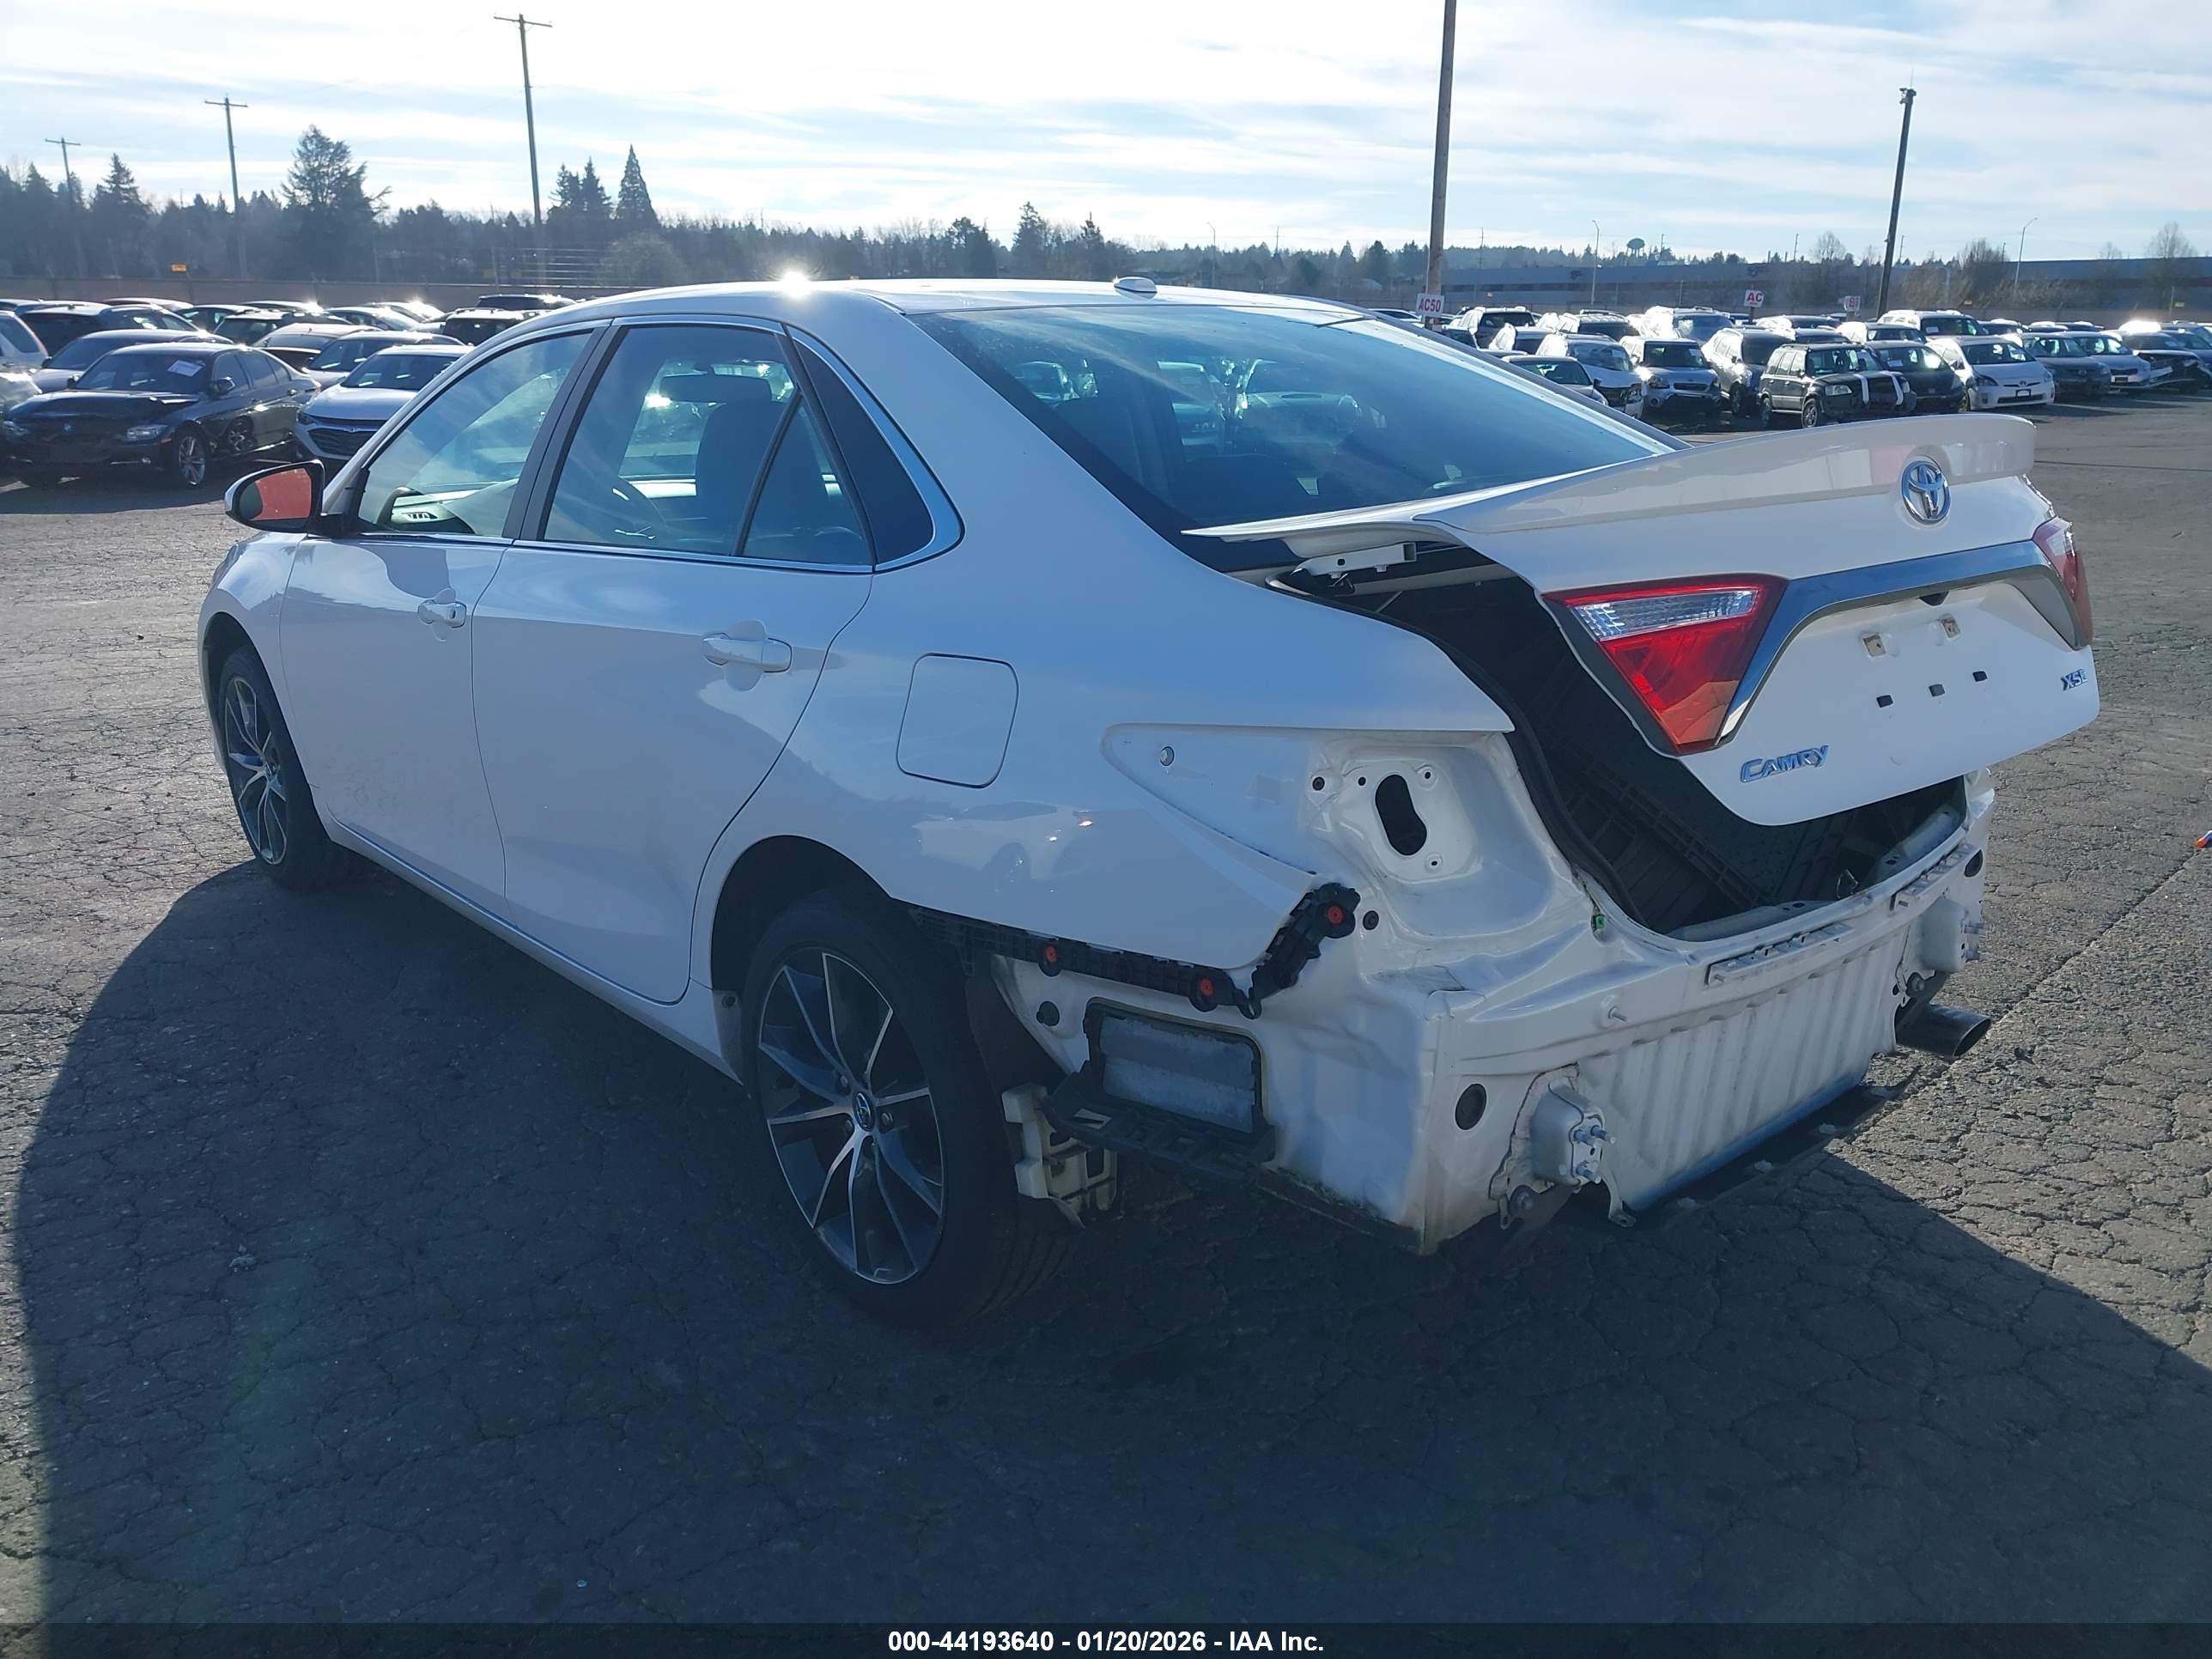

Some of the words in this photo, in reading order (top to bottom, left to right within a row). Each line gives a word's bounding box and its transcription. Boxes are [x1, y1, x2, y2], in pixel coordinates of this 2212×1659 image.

[1418, 297, 1442, 312] AC50
[2061, 669, 2088, 690] XSE
[1740, 744, 1829, 782] CAMRY
